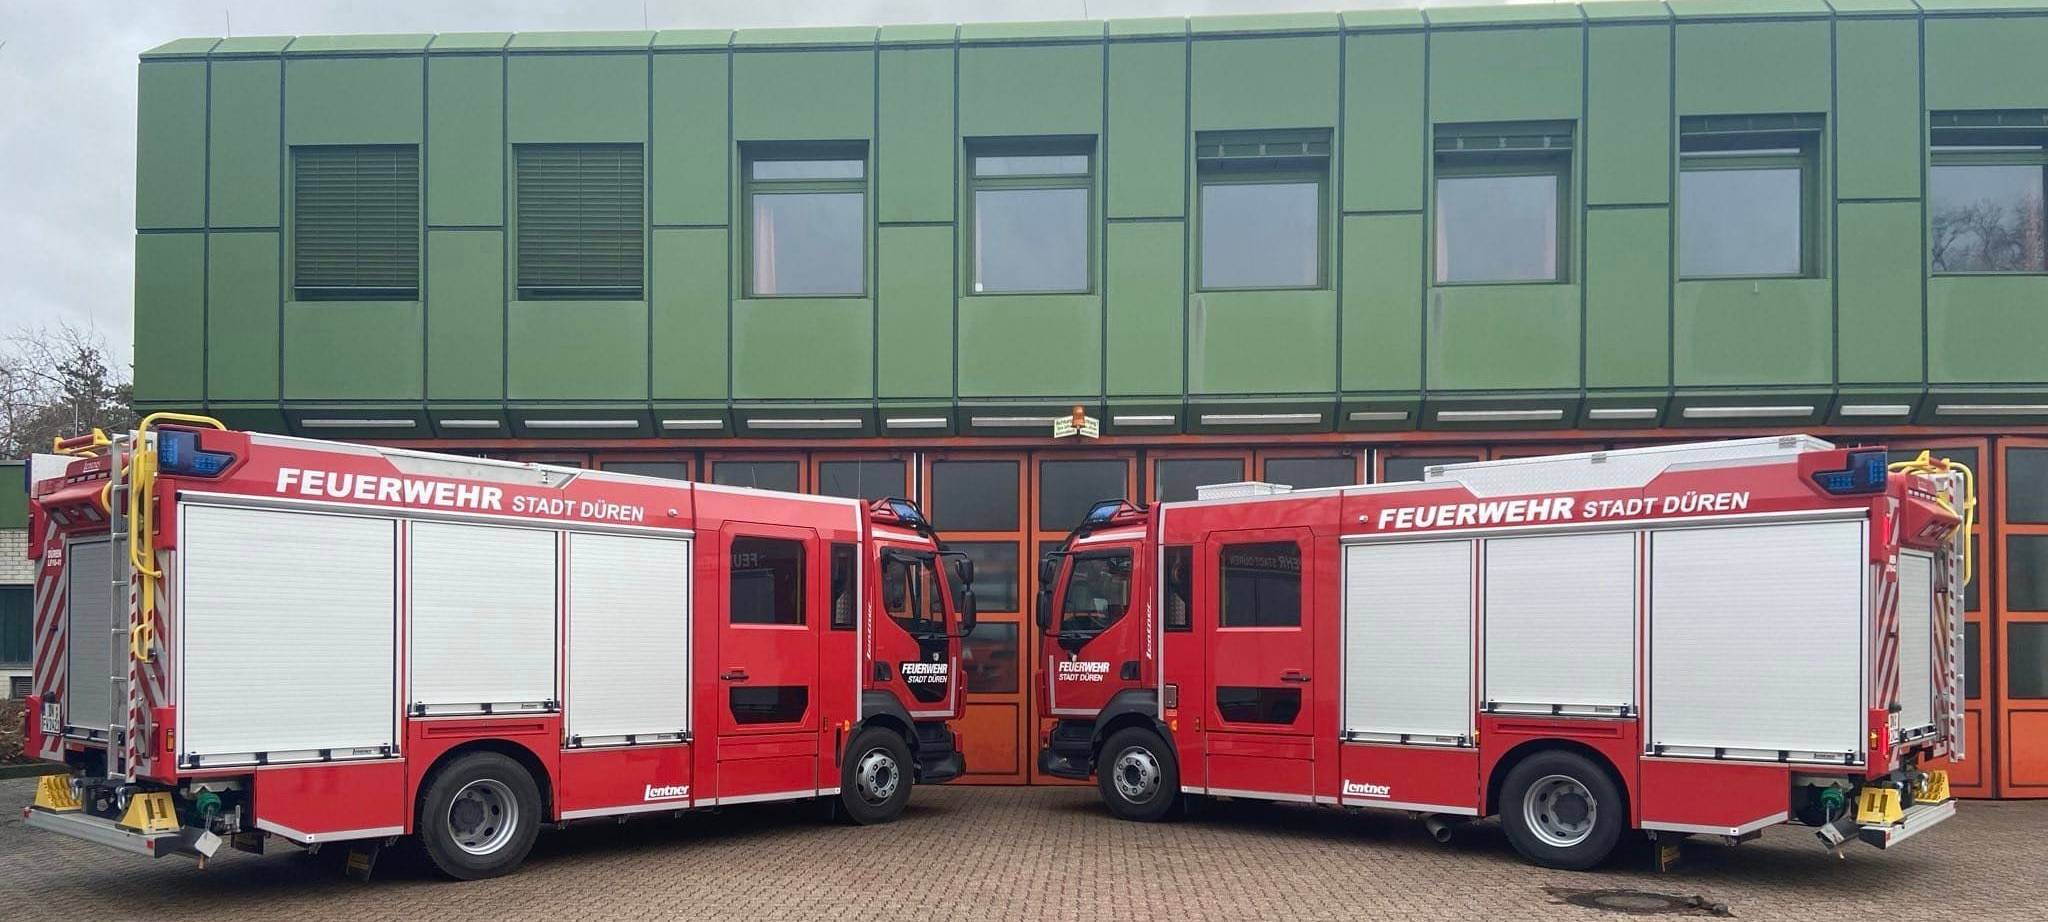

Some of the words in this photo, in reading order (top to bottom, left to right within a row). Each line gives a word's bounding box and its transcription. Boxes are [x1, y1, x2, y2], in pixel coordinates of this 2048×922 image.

[276, 467, 503, 511] FEUERWEHR
[512, 495, 575, 518] STADT
[580, 499, 645, 522] DÜREN
[1377, 497, 1575, 530] FEUERWEHR
[1582, 496, 1659, 518] STADT
[1662, 490, 1750, 515] DÜREN
[901, 663, 948, 675] FEUERWEHR
[1059, 661, 1110, 673] FEUERWEHR
[907, 675, 927, 684] STADT
[927, 674, 948, 683] DÜREN
[1058, 673, 1080, 681] STADT
[1080, 672, 1104, 682] DÜREN
[644, 783, 690, 801] Lentner
[1342, 779, 1391, 798] Lentner
